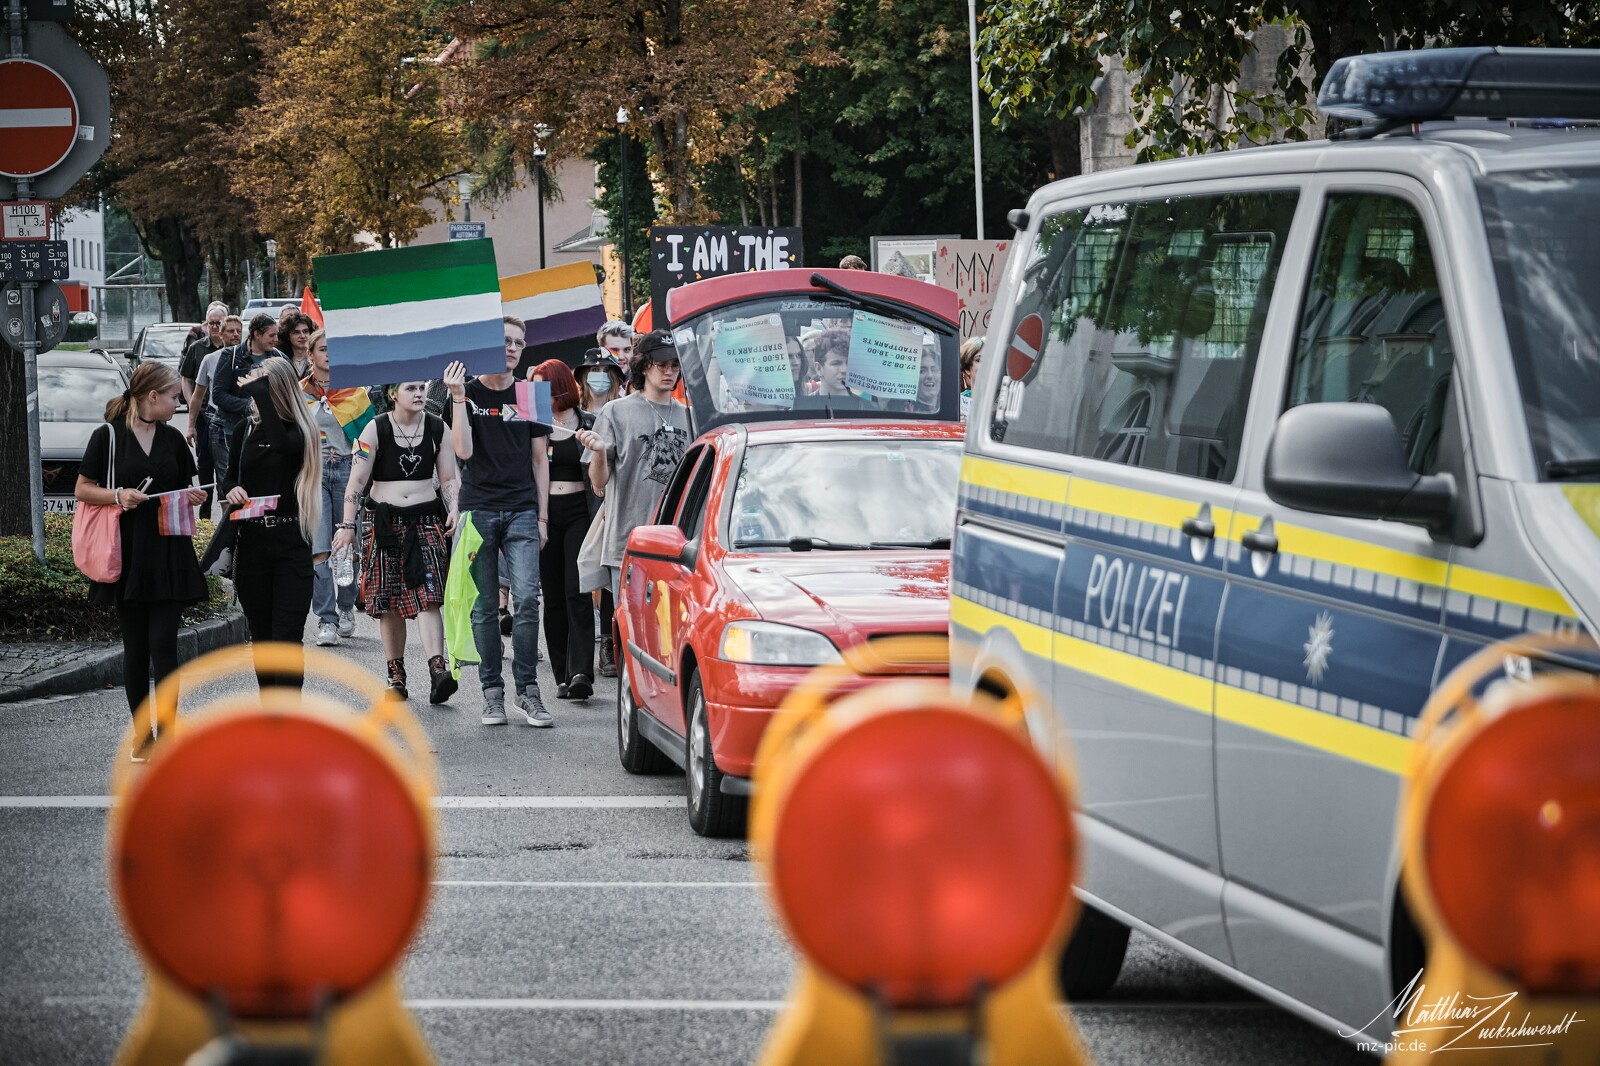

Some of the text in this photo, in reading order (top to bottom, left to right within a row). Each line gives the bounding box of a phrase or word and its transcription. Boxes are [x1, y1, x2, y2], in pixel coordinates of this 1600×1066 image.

[12, 206, 36, 214] H100
[666, 234, 790, 272] I AM THE
[956, 252, 994, 294] MY
[738, 344, 783, 355] STADTPARK
[867, 348, 889, 356] 18:00
[874, 340, 918, 354] STADTPARK
[763, 353, 784, 362] 15:00
[895, 353, 917, 362] 15:00
[882, 360, 916, 370] 27.08.22
[849, 372, 877, 384] COLOURS
[848, 377, 897, 393] TRAUNSTEIN
[1084, 554, 1190, 648] POLIZEI
